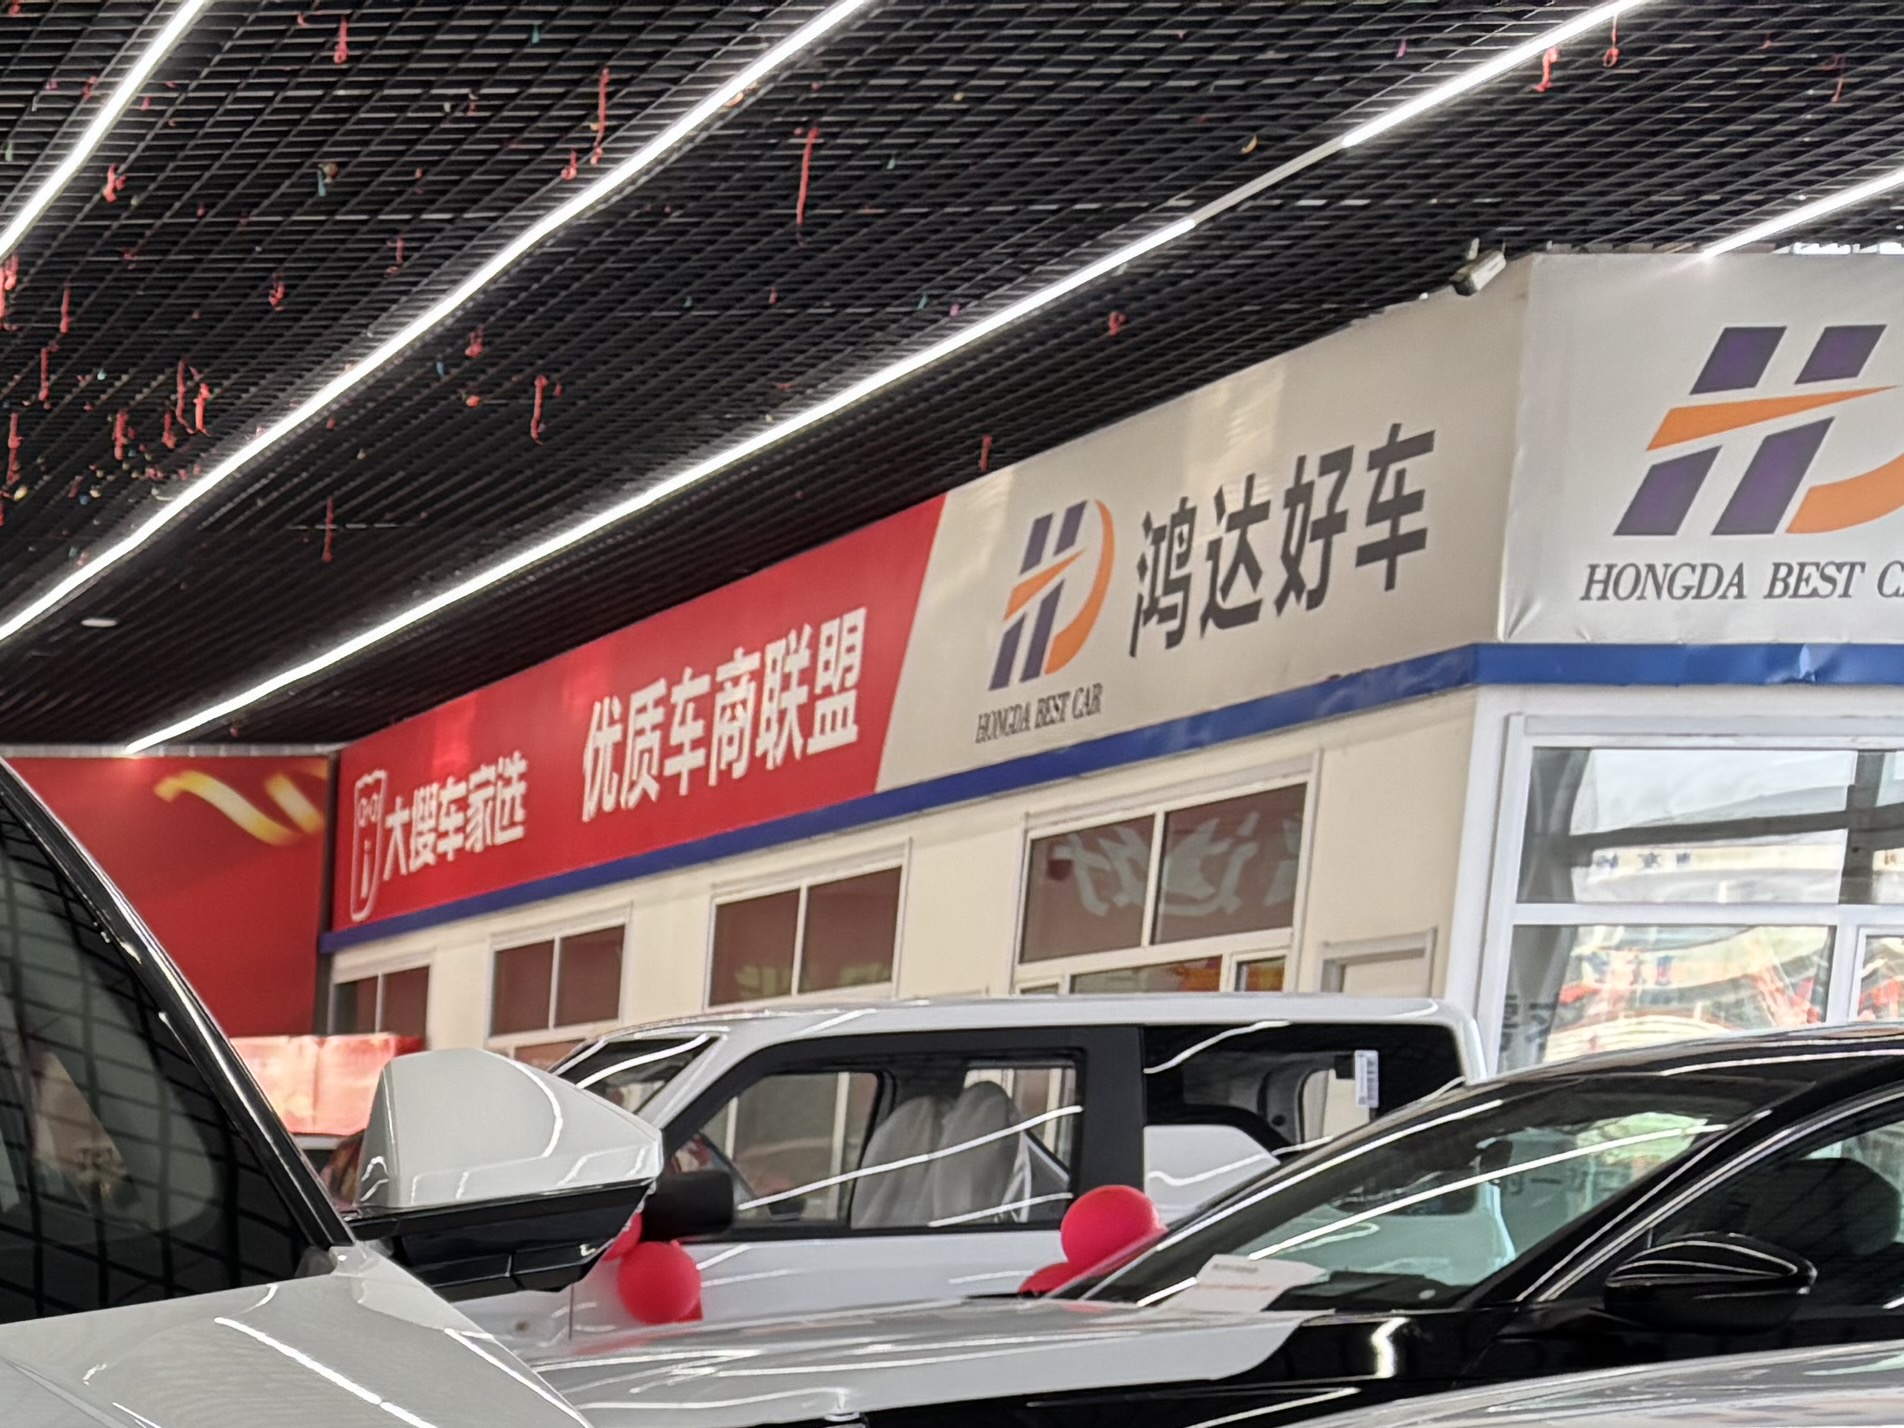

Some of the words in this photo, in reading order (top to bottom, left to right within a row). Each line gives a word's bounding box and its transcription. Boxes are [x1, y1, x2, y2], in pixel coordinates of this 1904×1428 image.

[1129, 423, 1436, 659] 鸿达好车
[1579, 561, 1747, 601] HONGDA
[1763, 560, 1866, 600] BEST
[581, 606, 867, 823] 优质车商联盟
[975, 701, 1031, 744] HONGDA
[1034, 690, 1071, 729] BEST
[1072, 682, 1103, 720] CAR
[382, 749, 529, 882] 大搜车家选
